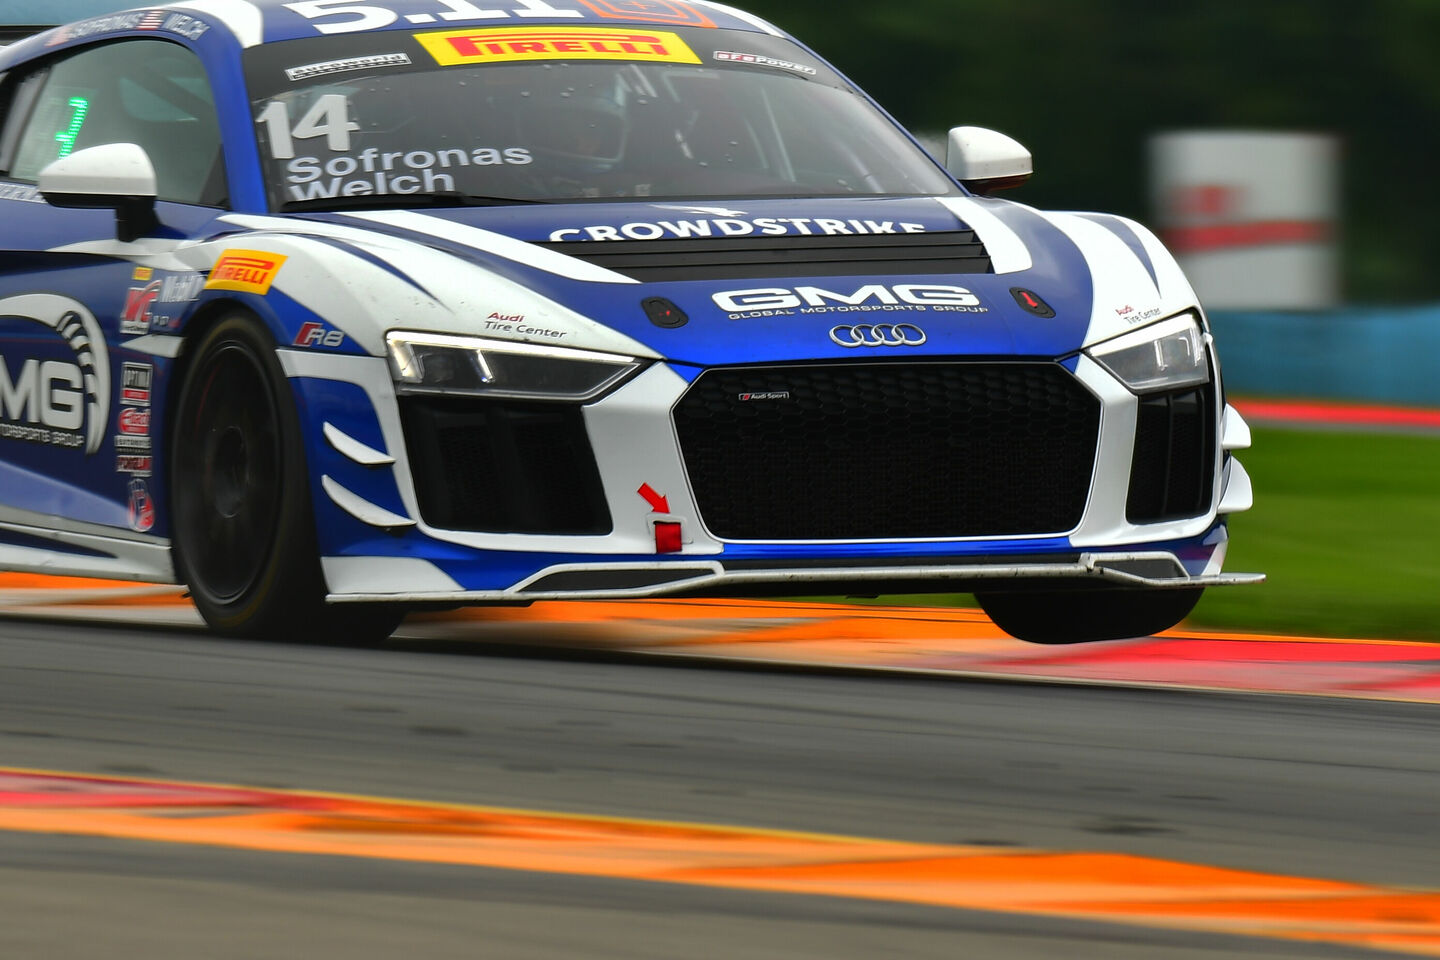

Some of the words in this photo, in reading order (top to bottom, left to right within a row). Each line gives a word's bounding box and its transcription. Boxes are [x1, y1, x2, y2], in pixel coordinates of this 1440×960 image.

[446, 35, 668, 57] PIRELLI
[255, 94, 360, 159] 14
[287, 147, 533, 183] Sofronas
[289, 169, 455, 202] Welch
[549, 217, 927, 242] CROWDSTRIKE
[212, 256, 275, 285] PIRELLI
[712, 284, 980, 313] GMG
[487, 311, 525, 322] Audi
[728, 309, 796, 320] GLOBAL
[800, 304, 927, 315] MOTORSPORTS
[932, 304, 989, 314] GROUP
[302, 327, 345, 347] R8
[484, 320, 512, 332] Tire
[516, 324, 568, 338] Center
[767, 392, 787, 401] Sport
